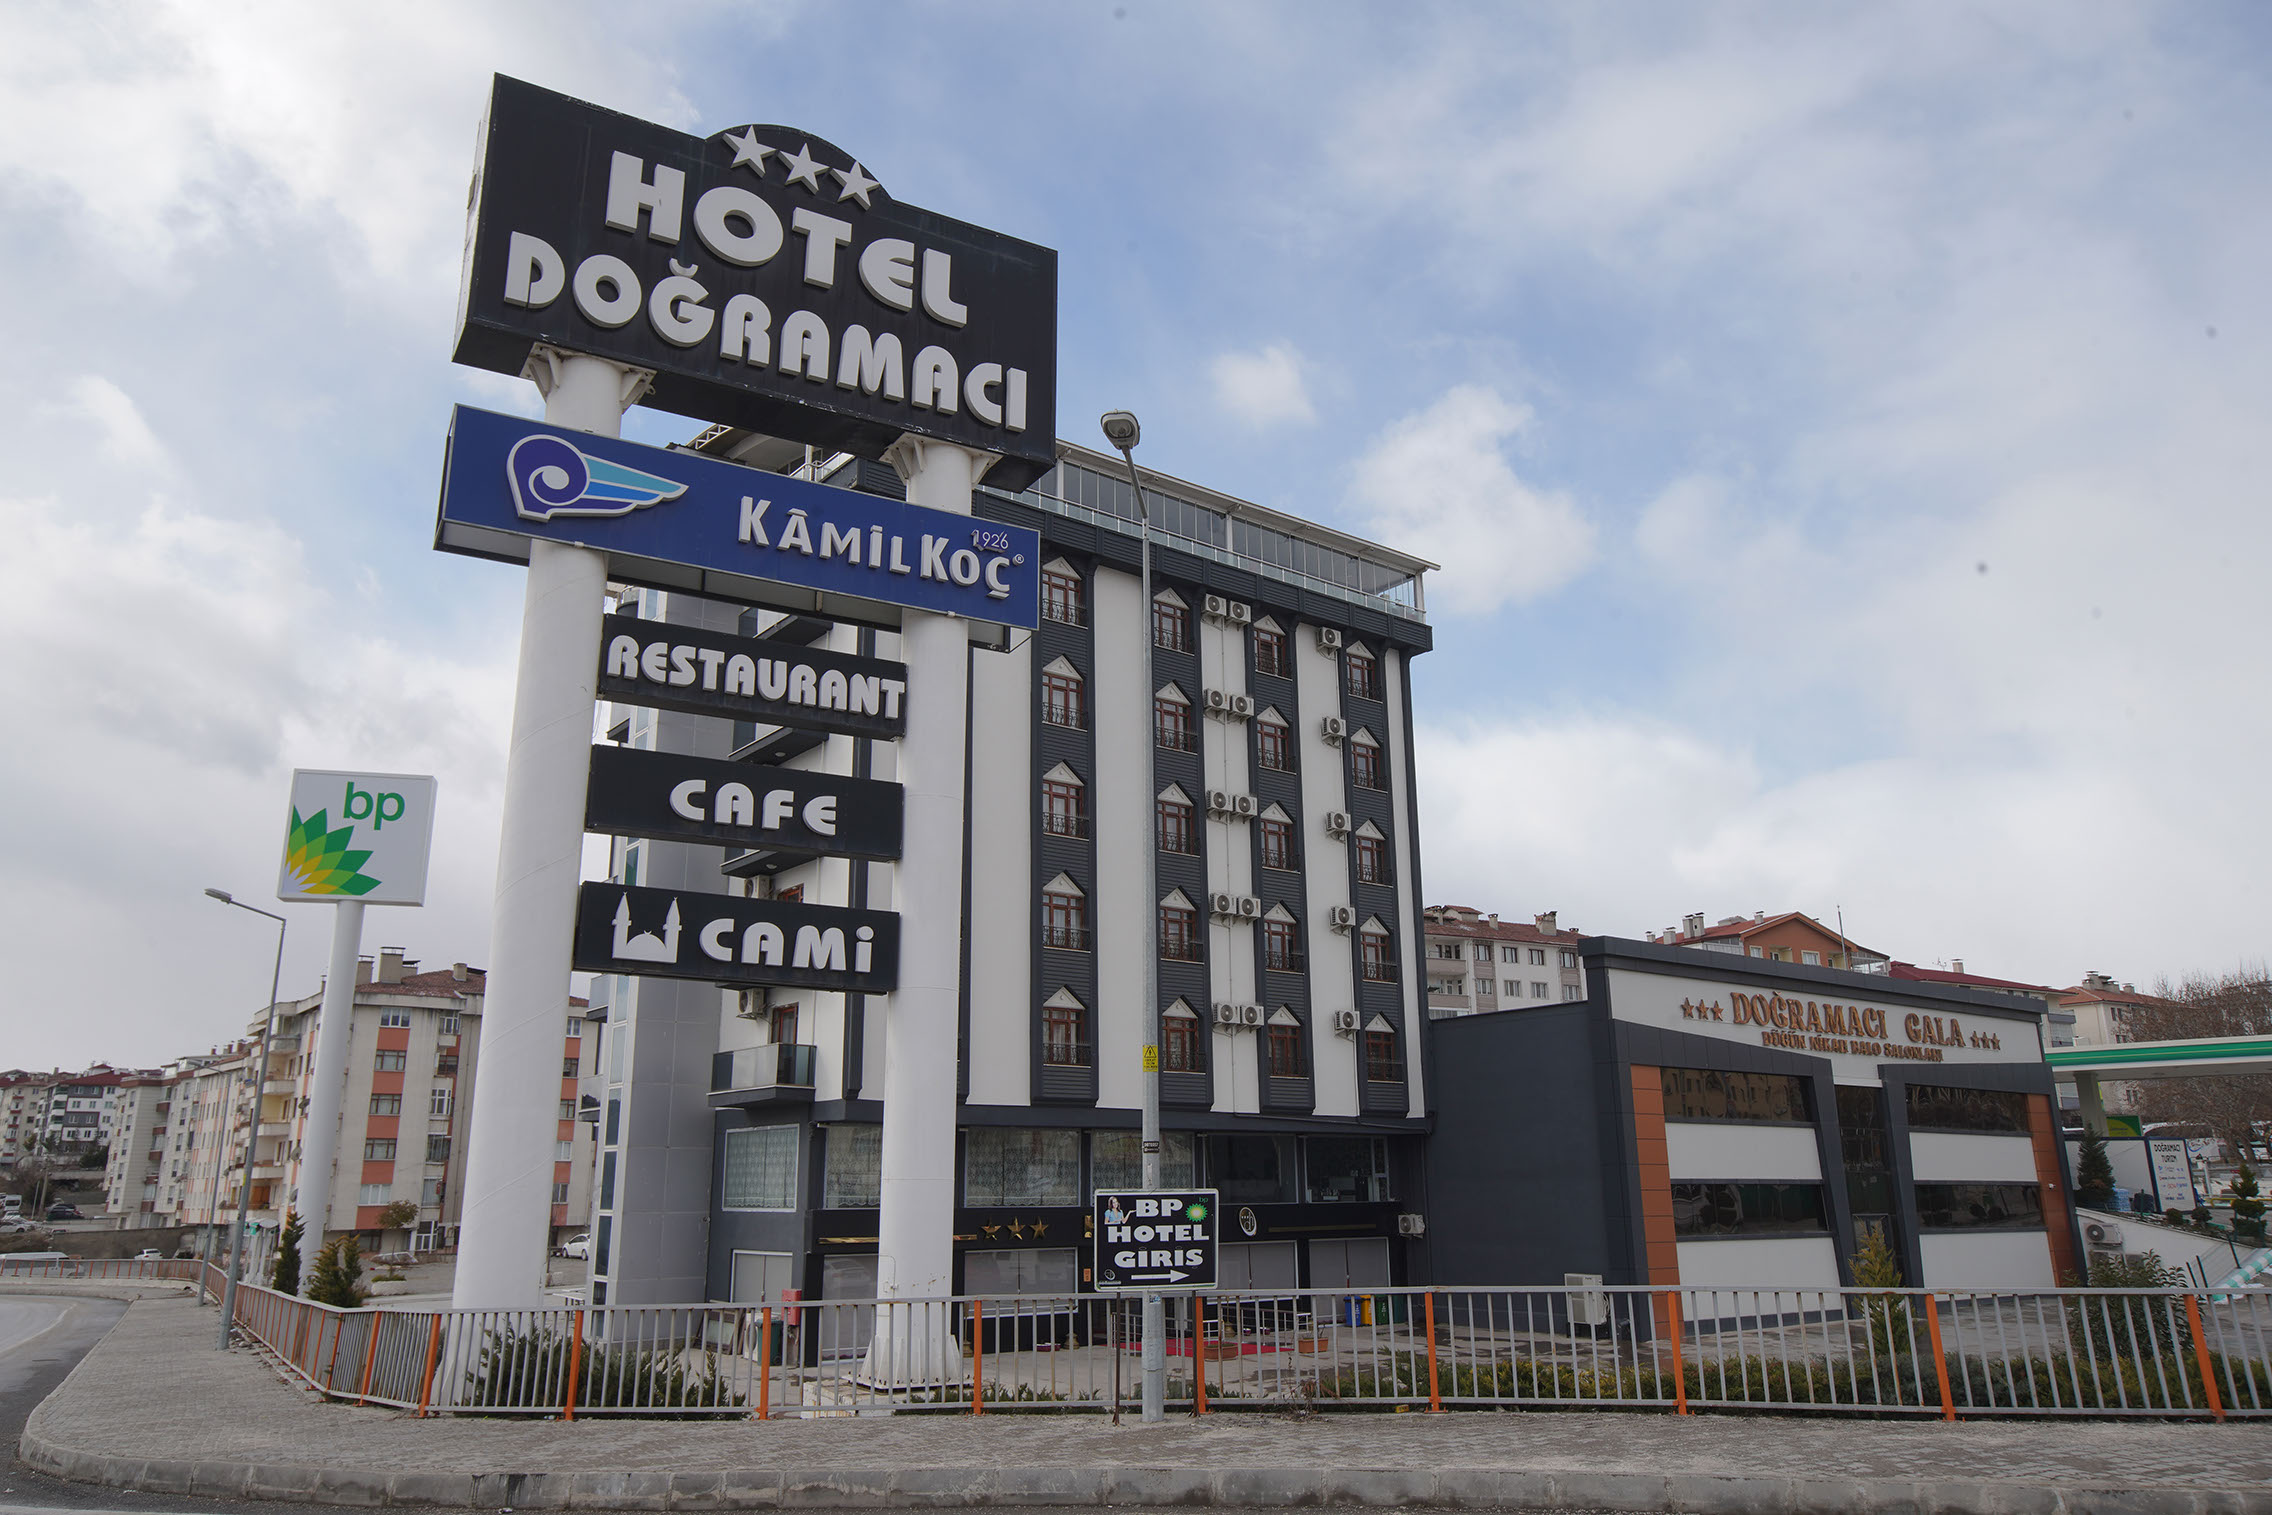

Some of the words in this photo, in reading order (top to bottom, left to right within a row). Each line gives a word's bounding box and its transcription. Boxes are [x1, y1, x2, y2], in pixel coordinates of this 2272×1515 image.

[604, 150, 967, 328] HOTEL
[503, 231, 1028, 432] DOĞRAMACI
[971, 529, 1009, 553] 1926
[606, 635, 905, 719] RESTAURANT
[343, 781, 405, 831] bp
[669, 779, 837, 836] CAFE
[1730, 991, 1889, 1039] DOĞRAMACI
[1904, 1012, 1966, 1047] GALA
[1108, 1224, 1209, 1243] HOTEL
[1136, 1199, 1183, 1217] BP
